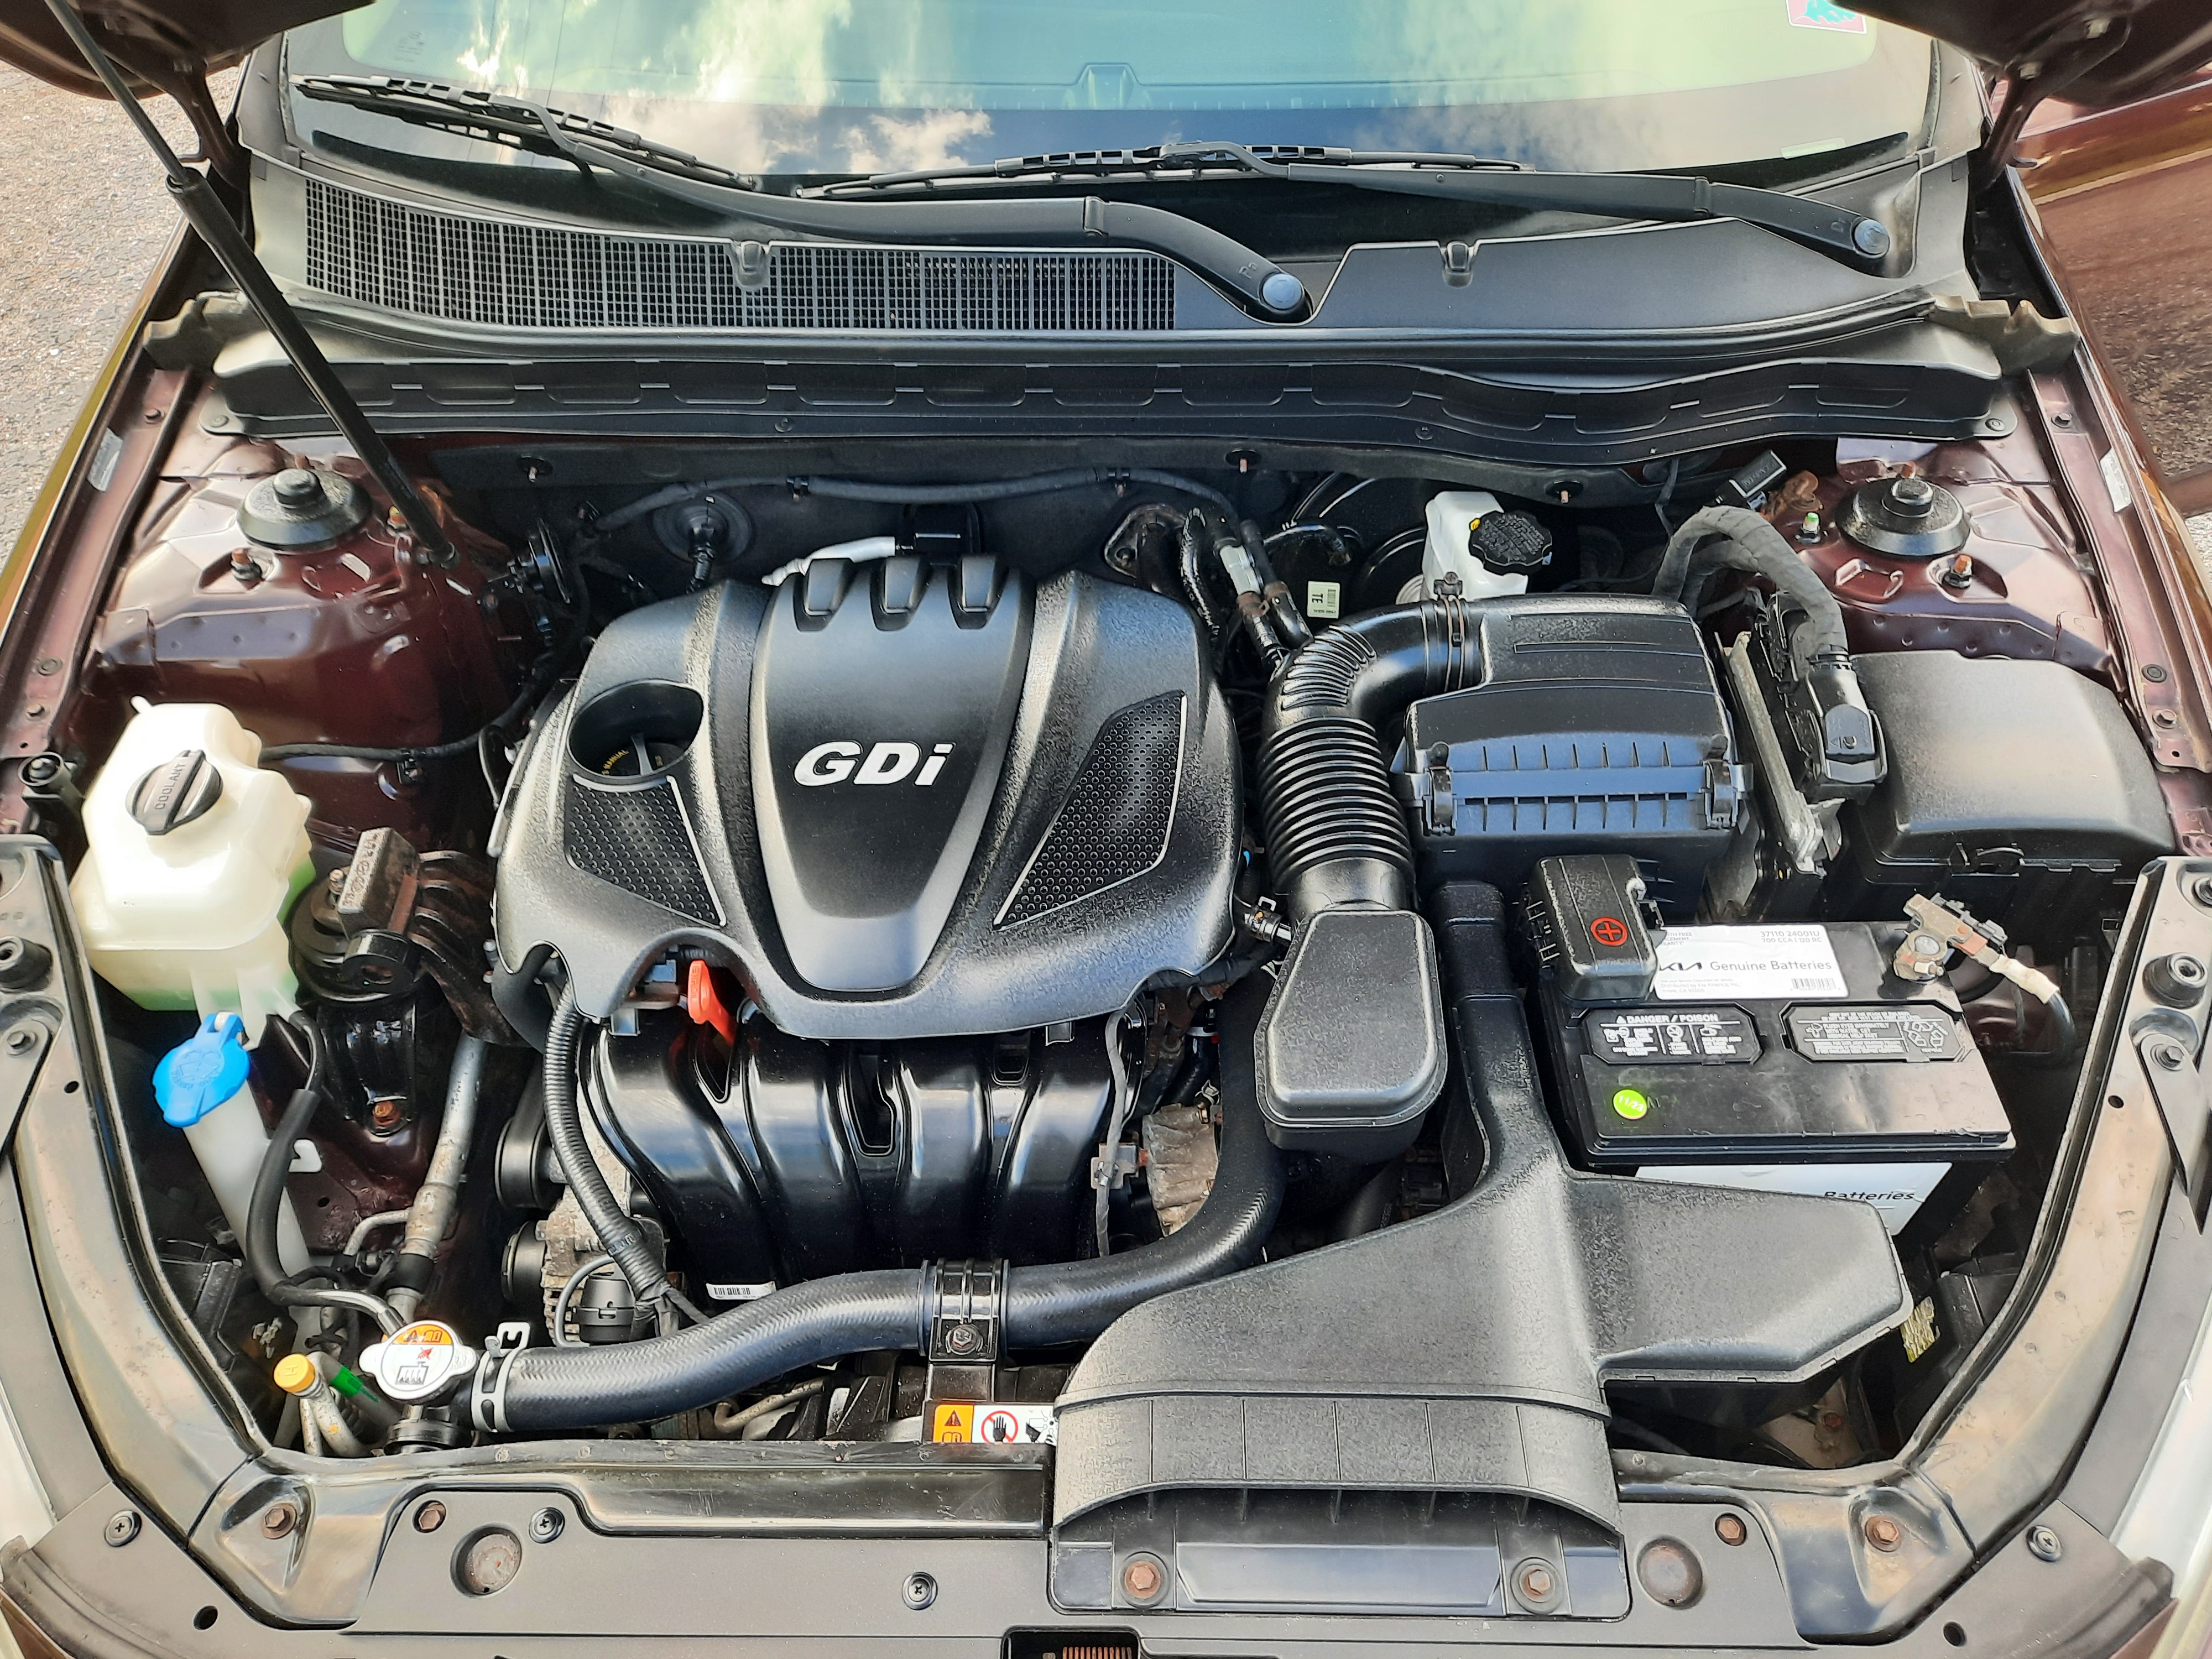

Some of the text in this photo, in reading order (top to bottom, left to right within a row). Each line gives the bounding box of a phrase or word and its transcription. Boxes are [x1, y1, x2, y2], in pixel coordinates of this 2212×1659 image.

[1312, 593, 1323, 603] TE
[603, 750, 629, 769] MANUAL
[794, 740, 955, 786] GDi
[155, 763, 186, 810] COOLANT
[1710, 961, 1766, 971] Genuine
[1771, 961, 1832, 970] Batteries
[1825, 1191, 1914, 1200] Batteries
